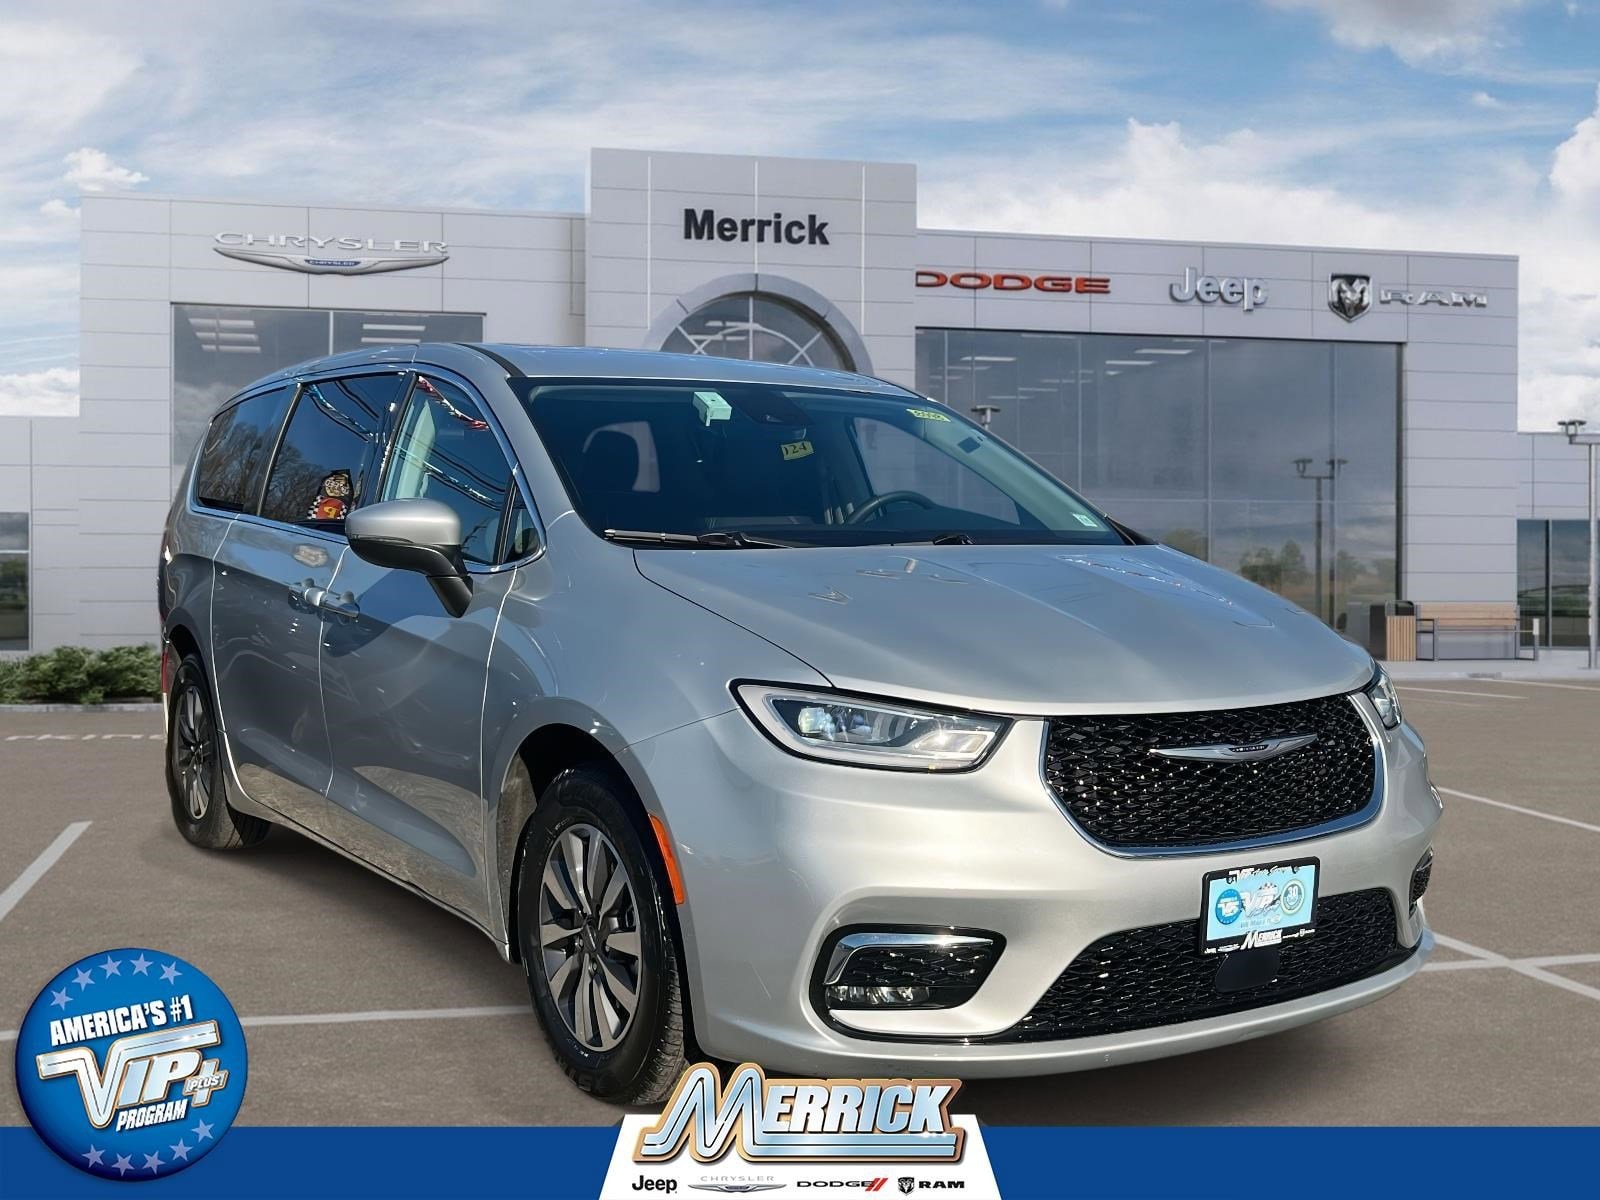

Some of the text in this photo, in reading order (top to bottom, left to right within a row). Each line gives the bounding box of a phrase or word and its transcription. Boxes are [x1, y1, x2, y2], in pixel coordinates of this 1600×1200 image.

[684, 208, 830, 245] Merrick
[214, 232, 449, 253] CHRYSLER
[915, 271, 1111, 294] DODGE
[1169, 267, 1268, 312] Jeep
[1379, 289, 1488, 308] RAM
